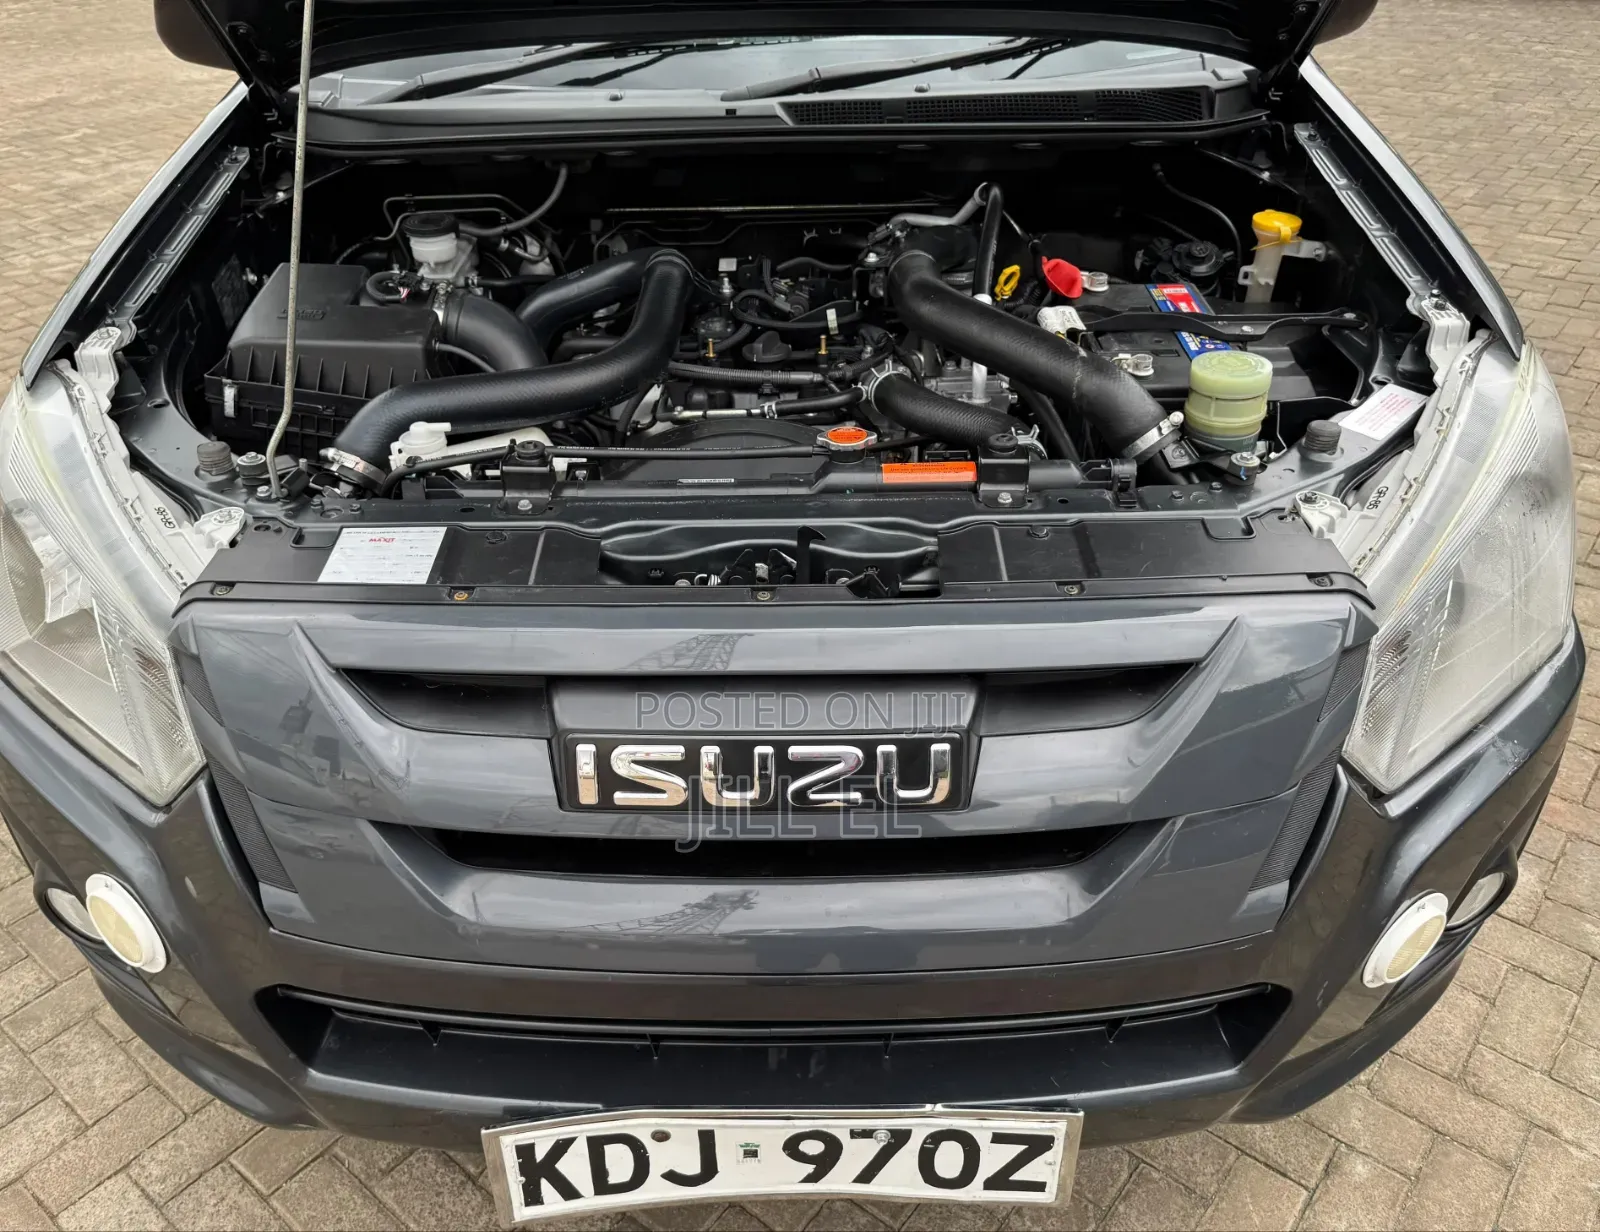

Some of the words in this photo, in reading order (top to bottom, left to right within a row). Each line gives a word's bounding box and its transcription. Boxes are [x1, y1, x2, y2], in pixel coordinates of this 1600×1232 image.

[576, 743, 951, 806] ISUZU
[515, 1129, 719, 1207] KDJ
[782, 1129, 1055, 1192] 970Z
